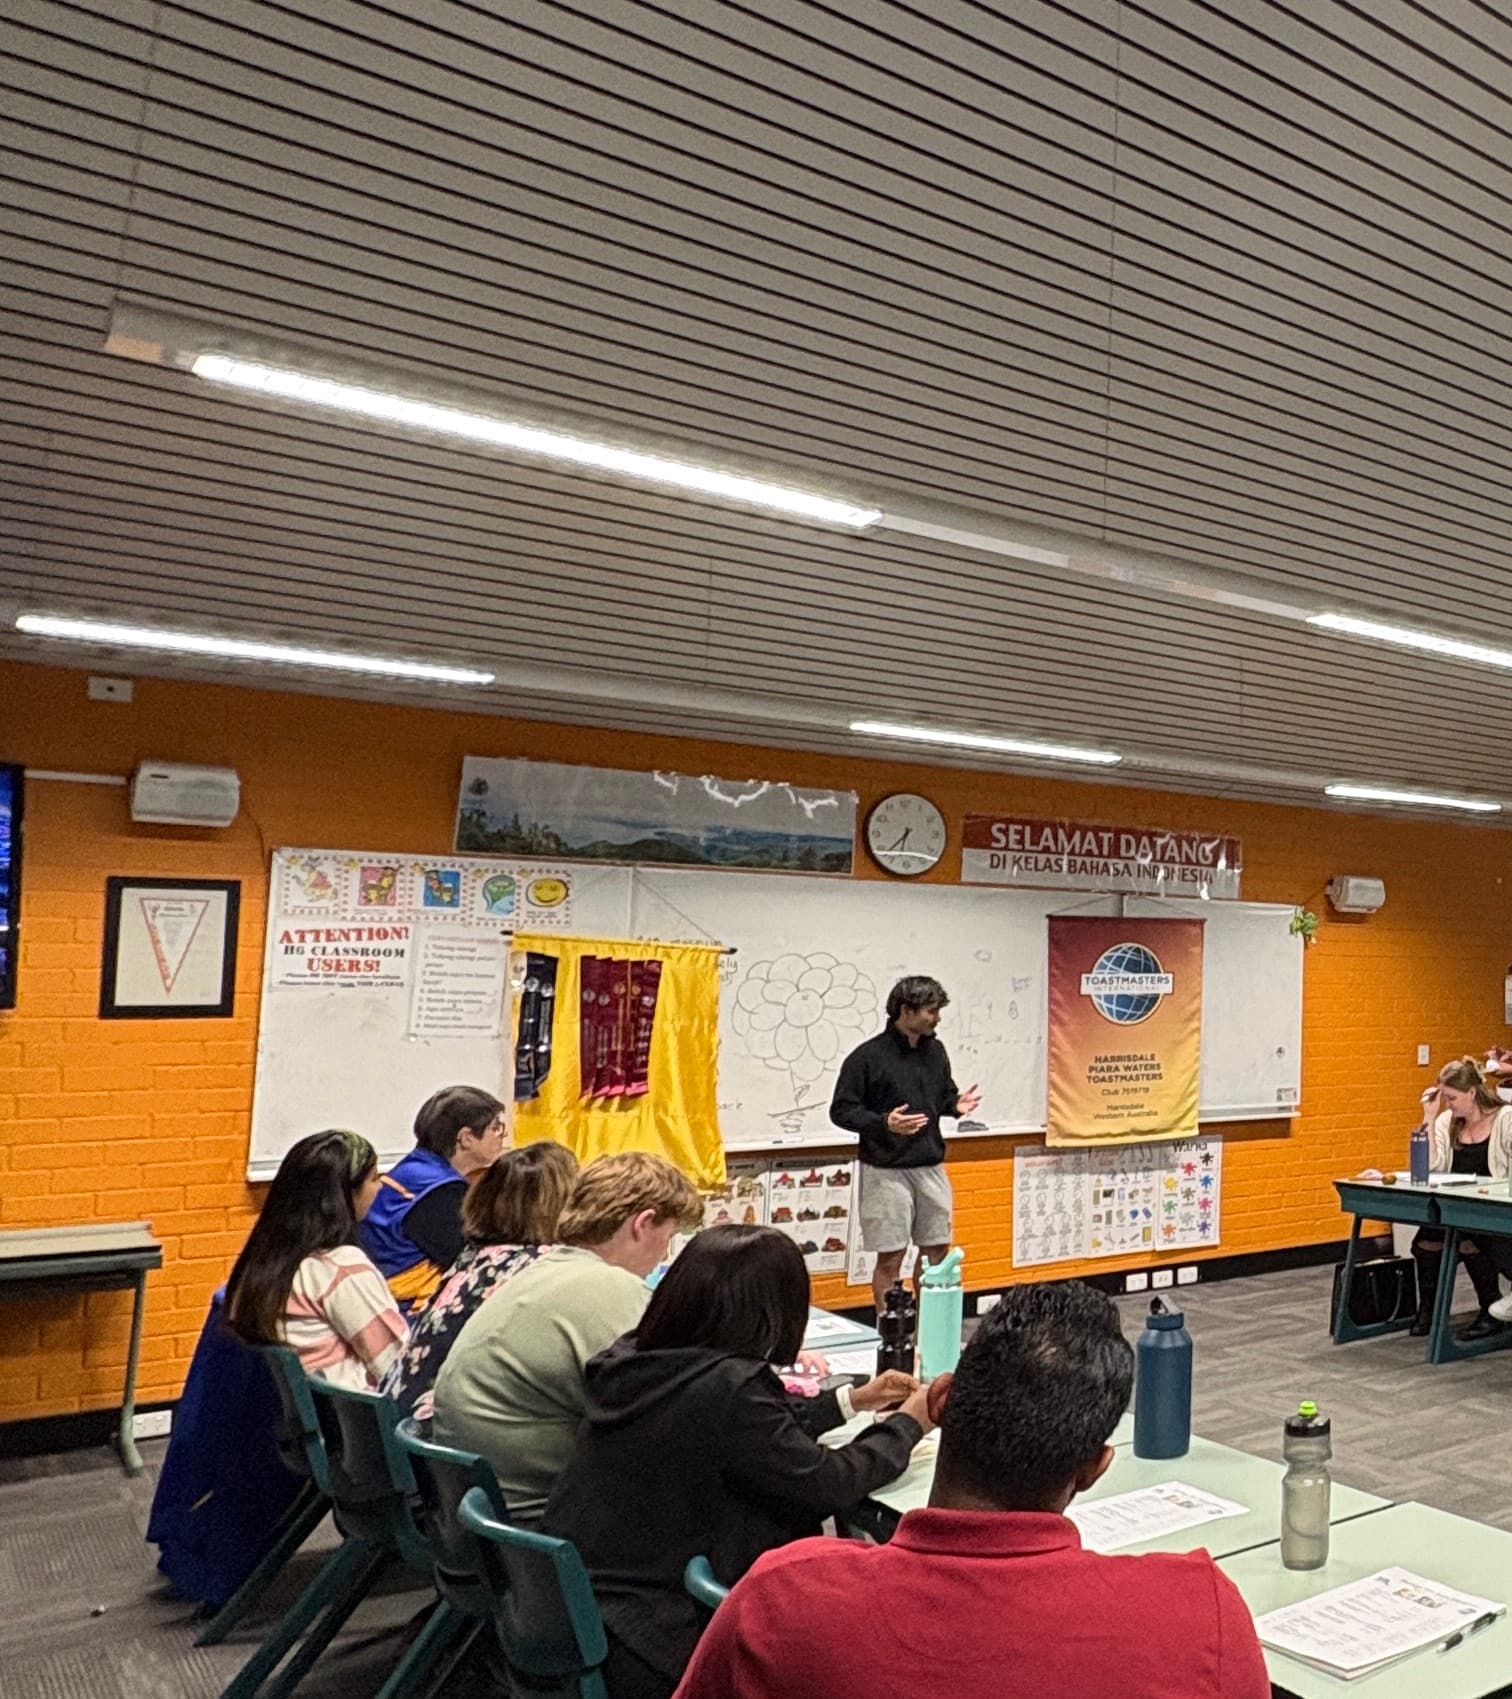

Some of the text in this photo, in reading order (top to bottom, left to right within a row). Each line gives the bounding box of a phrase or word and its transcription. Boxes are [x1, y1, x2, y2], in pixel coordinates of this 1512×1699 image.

[991, 823, 1213, 864] SELAMAT DATANG
[990, 853, 1213, 884] DI KELAS BAHASA INDONESIA
[279, 926, 409, 944] ATTENTION!
[311, 946, 405, 958] CLASSROOM
[307, 958, 381, 973] USERS!
[1084, 976, 1170, 985] TOASTMASTERS
[1094, 1053, 1156, 1064] HARRISDALE
[1088, 1063, 1162, 1073] PIARA WATERS
[1087, 1073, 1163, 1084] TOASTMASTERS
